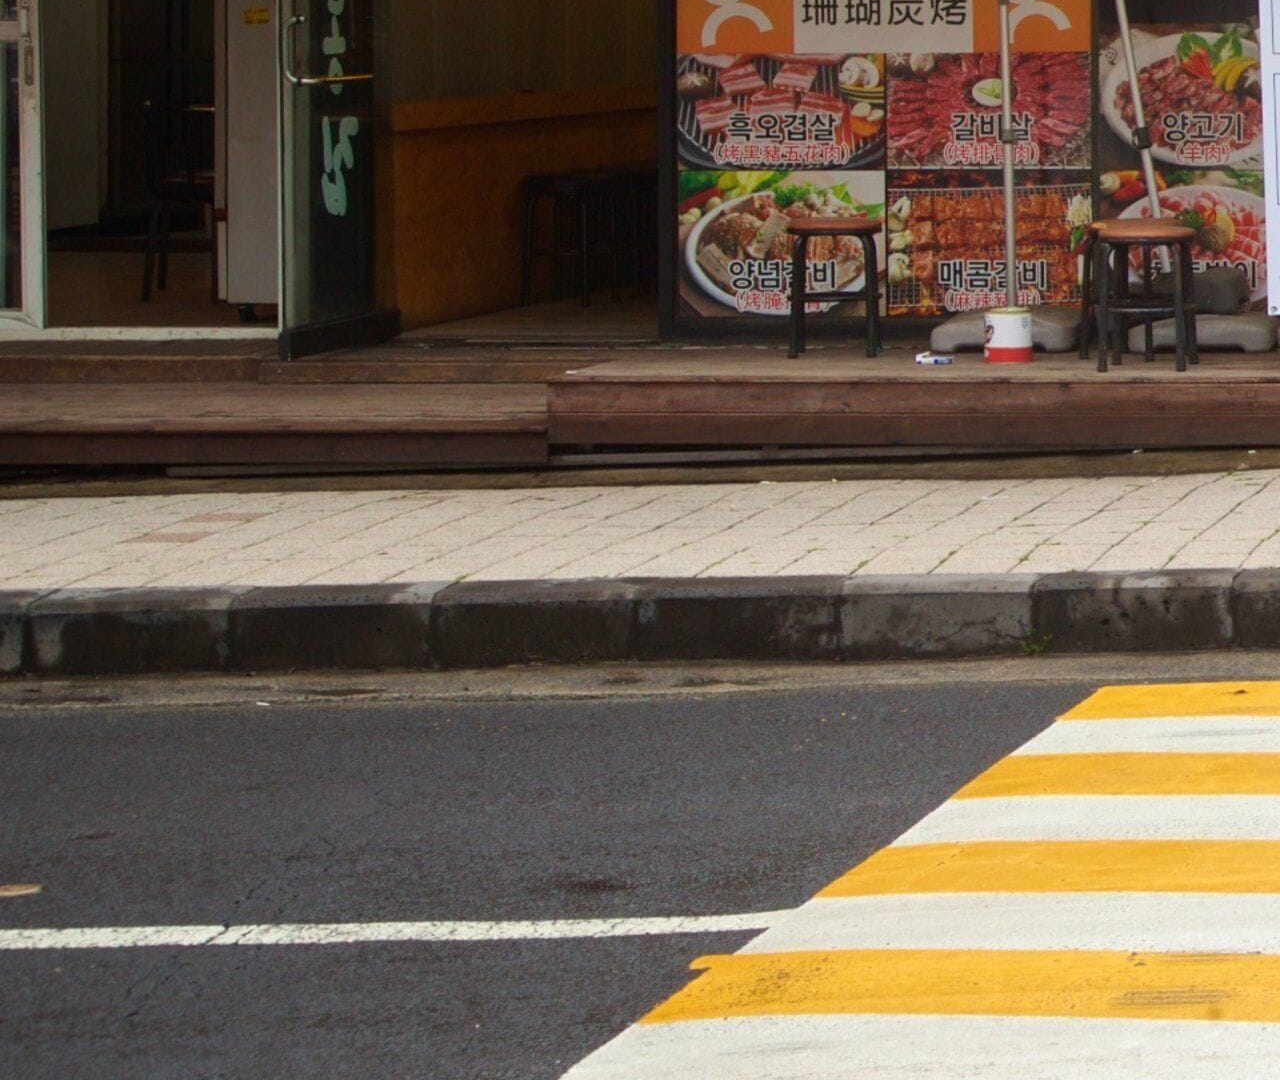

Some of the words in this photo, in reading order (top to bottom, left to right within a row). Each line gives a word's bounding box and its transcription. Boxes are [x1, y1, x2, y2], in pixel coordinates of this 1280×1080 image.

[726, 111, 840, 143] 흑오겹살
[951, 111, 1034, 142] 갈비살
[1162, 112, 1244, 142] 양고기
[1175, 141, 1231, 164] (羊肉)
